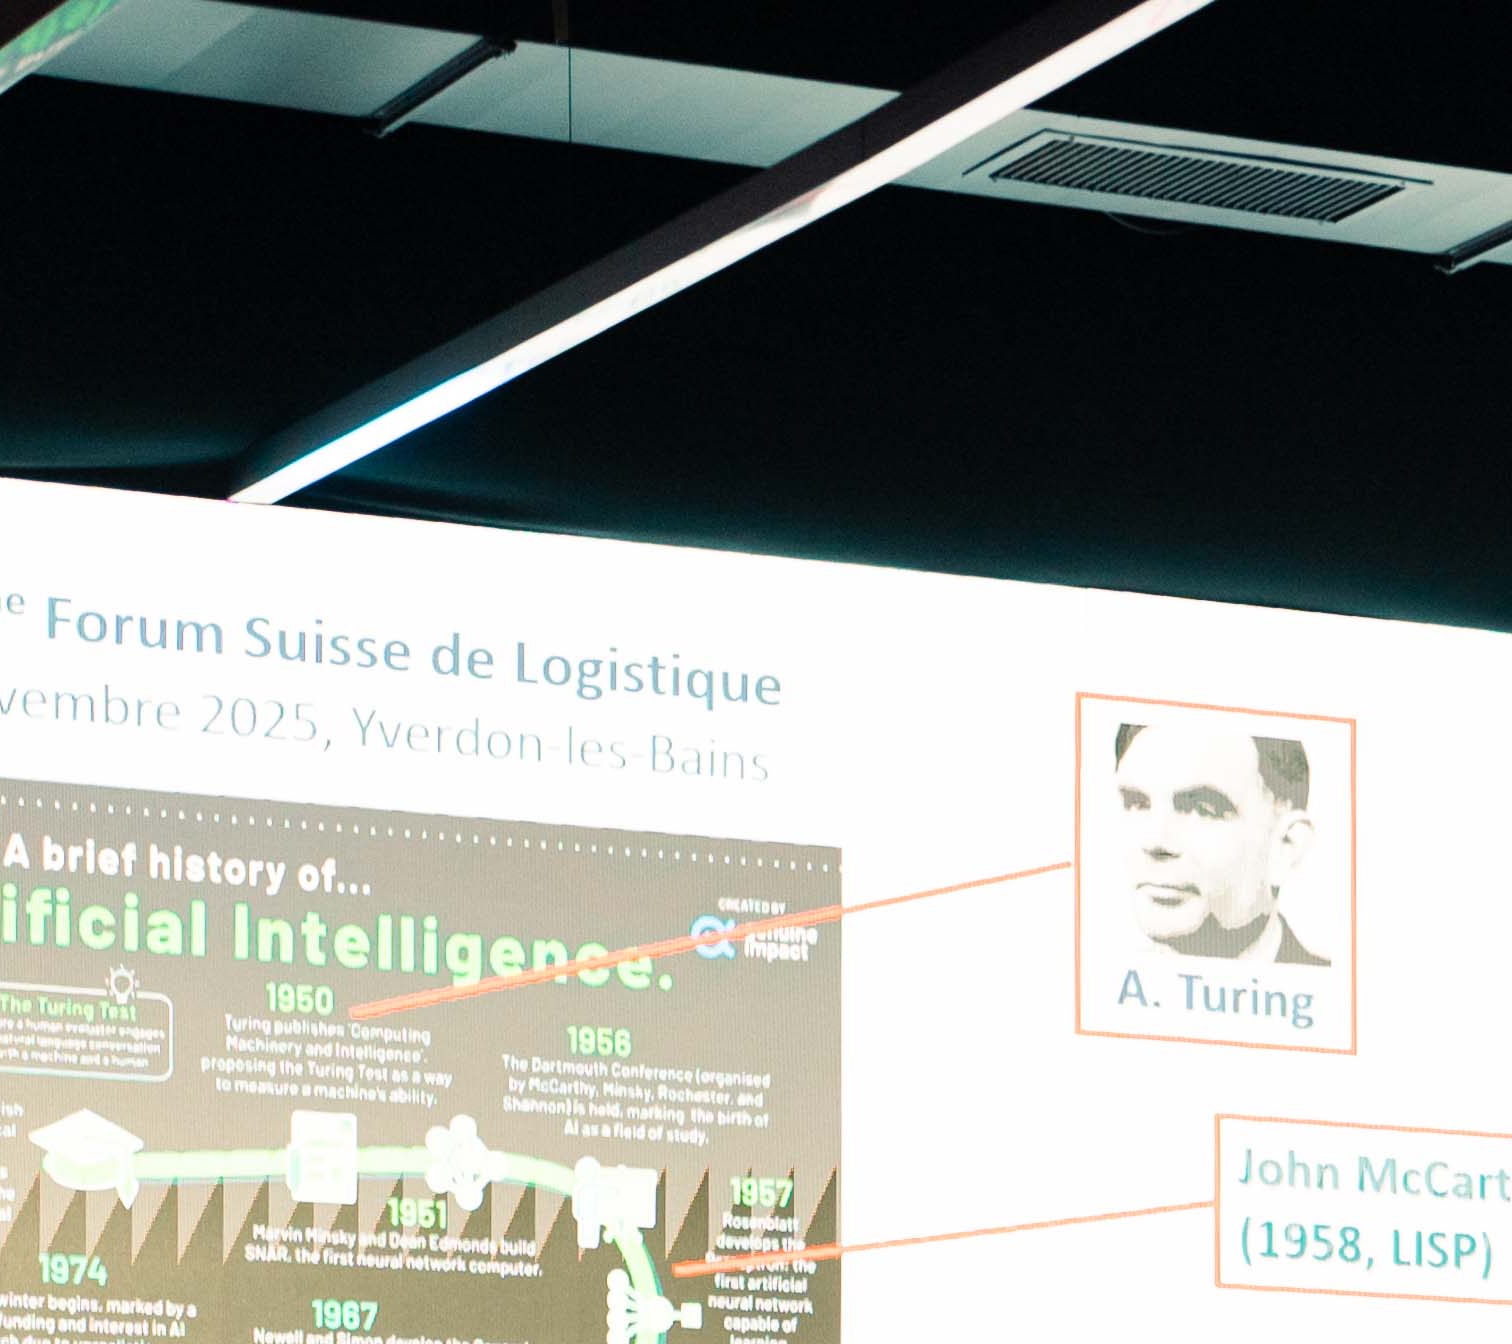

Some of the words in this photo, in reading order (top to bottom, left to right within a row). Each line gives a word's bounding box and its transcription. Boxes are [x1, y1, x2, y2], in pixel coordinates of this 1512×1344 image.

[47, 597, 224, 655] Forum
[244, 617, 411, 672] Suisse
[431, 632, 495, 679] de
[516, 641, 782, 711] Logistique
[201, 694, 332, 752] 2025,
[3, 832, 30, 869] A
[42, 836, 137, 877] brief
[149, 843, 286, 896] history
[0, 991, 32, 1015] The
[38, 995, 95, 1024] Turing
[100, 1001, 137, 1022] Test
[265, 980, 334, 1016] 1950
[1117, 967, 1162, 1012] A.
[1177, 971, 1317, 1031] Turing
[225, 1013, 272, 1036] Turing
[274, 1019, 345, 1038] publishes
[225, 1034, 303, 1057] Machinery
[305, 1042, 333, 1058] and
[201, 1056, 276, 1078] proposing
[279, 1060, 303, 1075] the
[308, 1061, 354, 1082] Turing
[359, 1064, 388, 1082] Test
[391, 1069, 409, 1083] as
[412, 1072, 421, 1084] a
[423, 1071, 453, 1089] way
[502, 1053, 528, 1072] The
[532, 1056, 608, 1077] Dartmouth
[611, 1062, 693, 1083] Conference
[215, 1077, 232, 1093] to
[234, 1079, 299, 1096] measure
[302, 1082, 311, 1096] a
[508, 1076, 526, 1095] by
[737, 1092, 763, 1108] and
[582, 1123, 599, 1137] as
[601, 1125, 612, 1138] a
[614, 1122, 645, 1140] field
[648, 1125, 663, 1142] of
[627, 1104, 685, 1126] marking
[691, 1108, 714, 1123] the
[717, 1110, 752, 1126] birth
[755, 1113, 769, 1128] of
[1237, 1144, 1342, 1194] John
[729, 1176, 793, 1208] 1957
[1239, 1215, 1377, 1273] (1958,
[1390, 1226, 1495, 1280] LISP)
[38, 1252, 109, 1288] 1974
[311, 1298, 379, 1332] 1967
